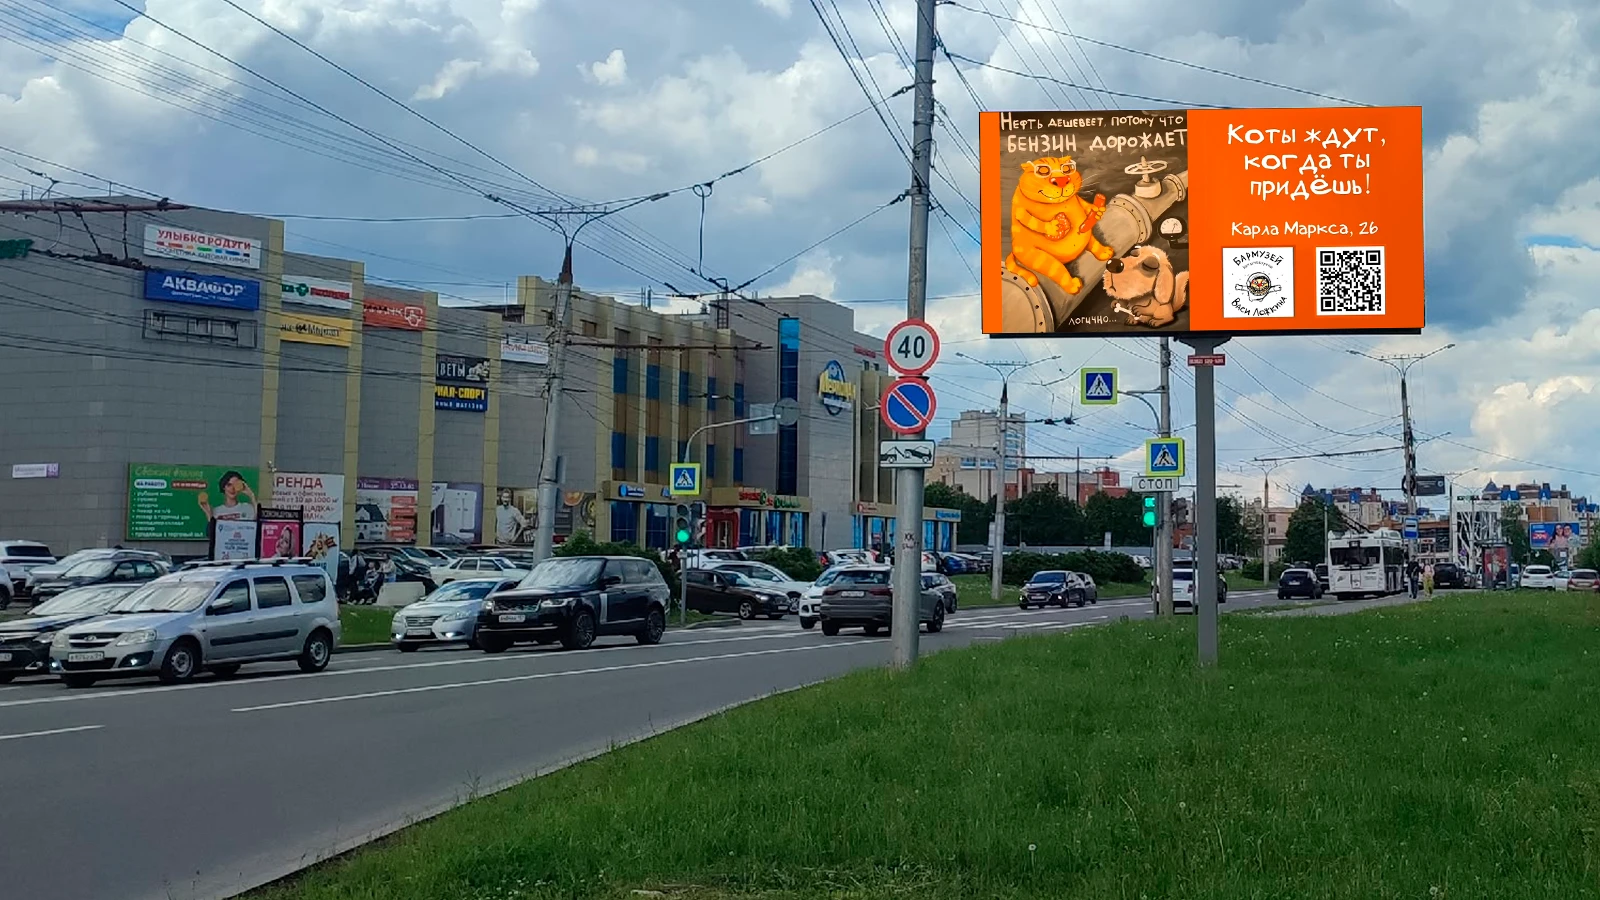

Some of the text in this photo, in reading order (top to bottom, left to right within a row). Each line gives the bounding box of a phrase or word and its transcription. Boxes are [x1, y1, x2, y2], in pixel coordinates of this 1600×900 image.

[1000, 112, 1043, 131] НЕФТЬ
[1111, 116, 1154, 128] ПОТОМУ
[1159, 115, 1184, 126] ЧТО
[1007, 128, 1188, 153] БЕНЗИН ДОРОЖАЕТ
[1228, 123, 1386, 149] Коты ждут,
[1244, 153, 1370, 175] когда ты
[1250, 173, 1371, 202] придёшь!
[158, 229, 252, 252] УЛЫБКА РАДУГИ
[1231, 221, 1379, 239] Карла Маркса, 26
[1232, 250, 1285, 267] БАРМУЗЕЙ
[162, 275, 244, 297] АКВАФОР
[897, 335, 925, 359] 40
[273, 476, 323, 489] РЕНДА
[1138, 478, 1173, 490] СТОП
